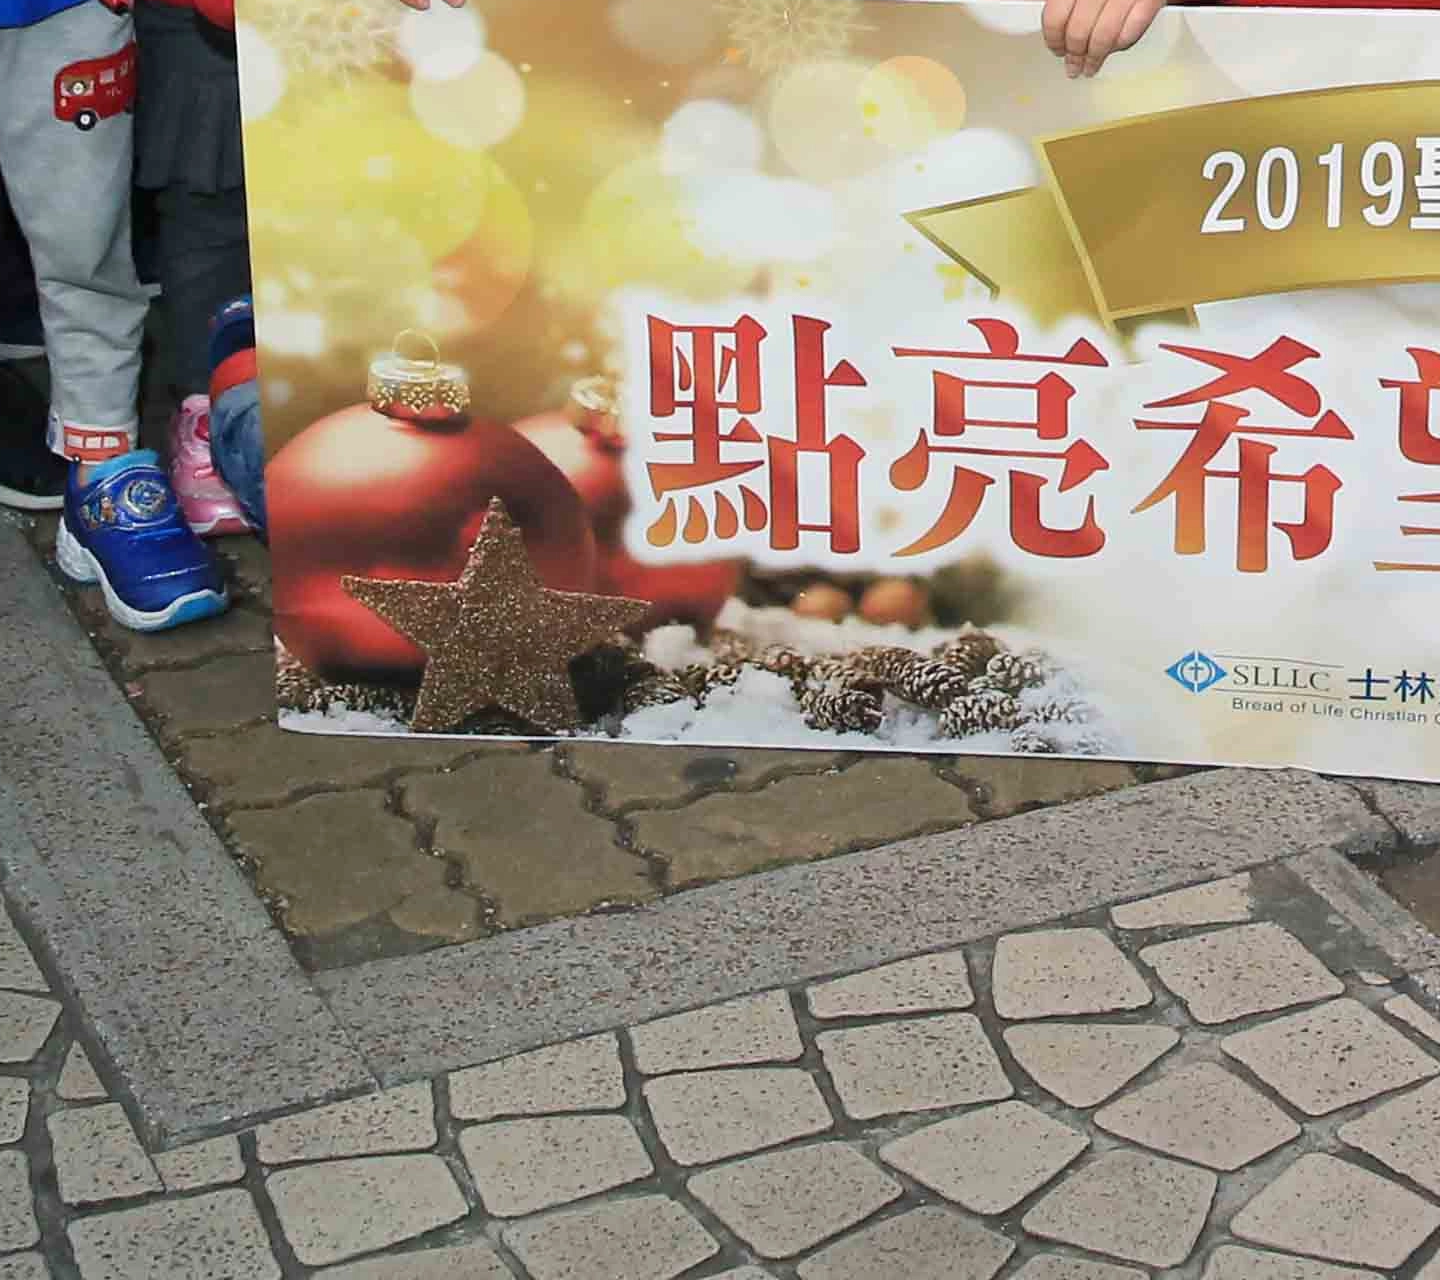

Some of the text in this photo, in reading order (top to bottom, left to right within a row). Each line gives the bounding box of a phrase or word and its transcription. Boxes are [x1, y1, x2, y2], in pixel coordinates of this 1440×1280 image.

[1232, 663, 1331, 693] SLLLC
[1231, 696, 1283, 714] Bread
[1289, 698, 1307, 714] of
[1312, 700, 1345, 720] Life
[1349, 705, 1428, 726] Christian
